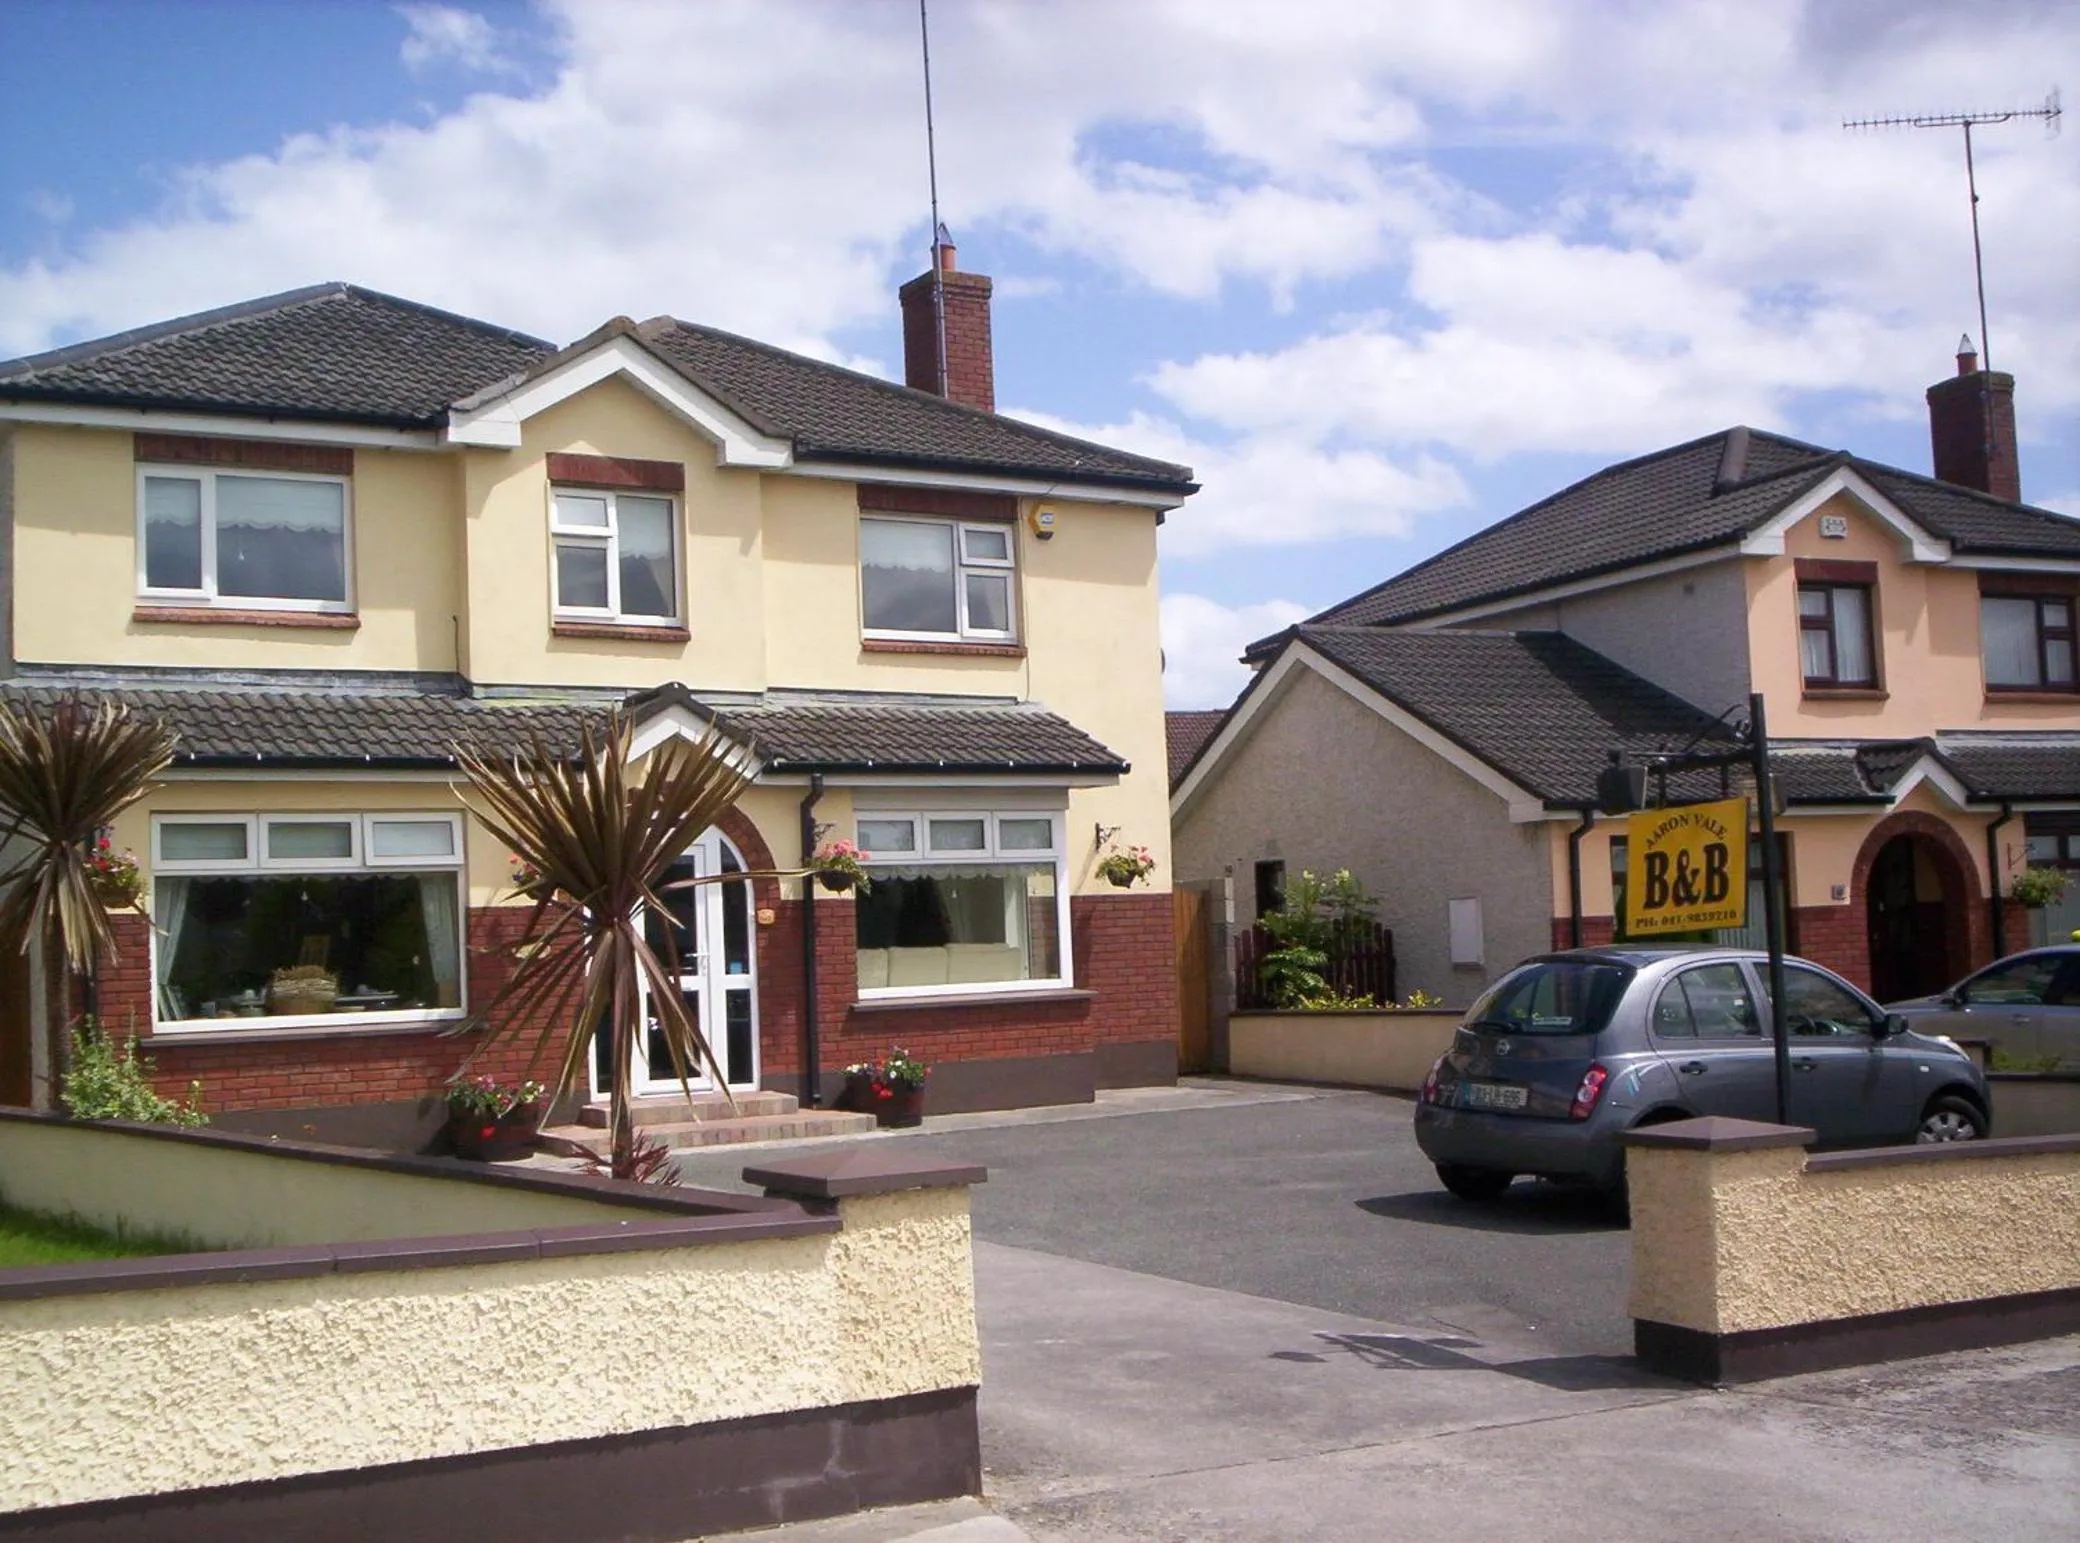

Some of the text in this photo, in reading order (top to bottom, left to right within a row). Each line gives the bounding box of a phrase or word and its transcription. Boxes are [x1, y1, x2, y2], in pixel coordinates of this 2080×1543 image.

[1646, 813, 1727, 849] AARON VALE
[1643, 842, 1729, 909] B&B
